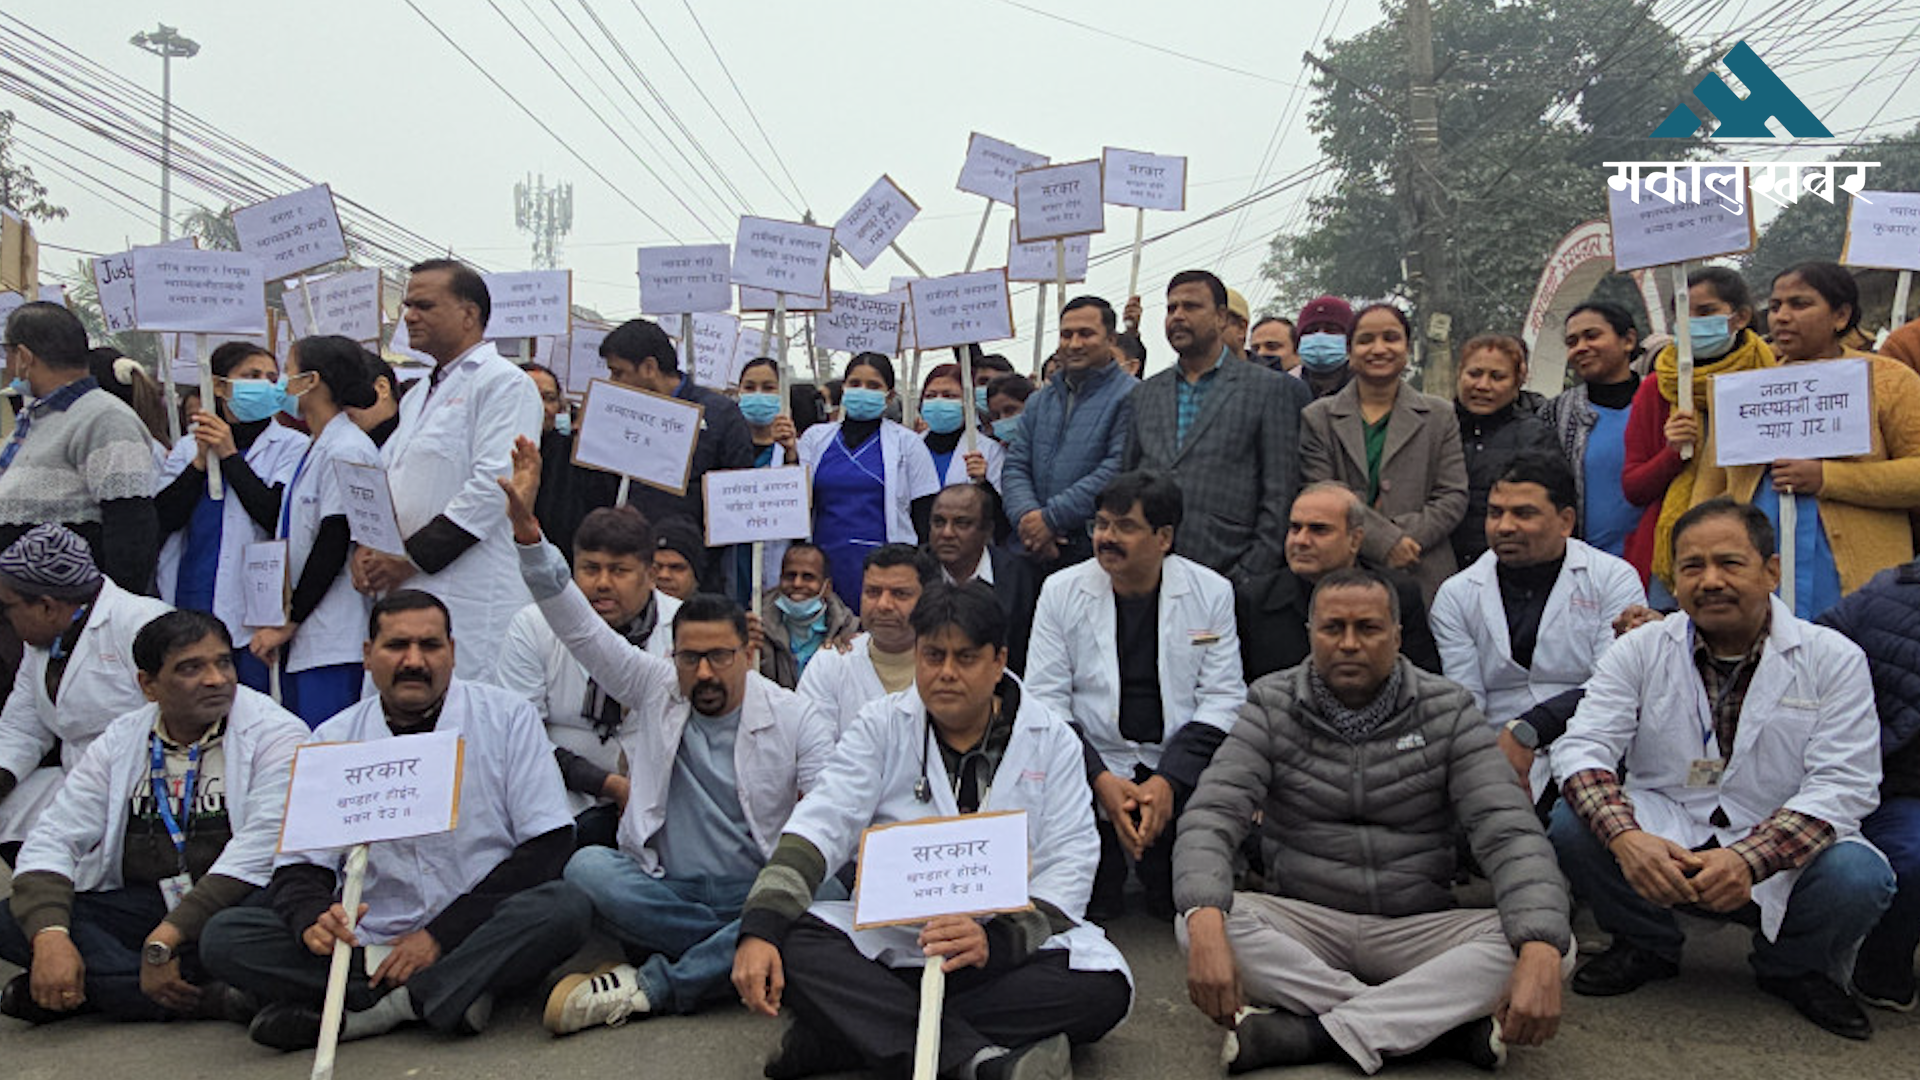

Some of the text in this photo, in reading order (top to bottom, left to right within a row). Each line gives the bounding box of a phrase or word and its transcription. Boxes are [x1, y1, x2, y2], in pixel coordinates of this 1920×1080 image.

[1128, 164, 1165, 178] सरकार
[1041, 180, 1080, 197] सरकार
[344, 757, 421, 785] सरकार
[912, 838, 990, 863] सरकार
